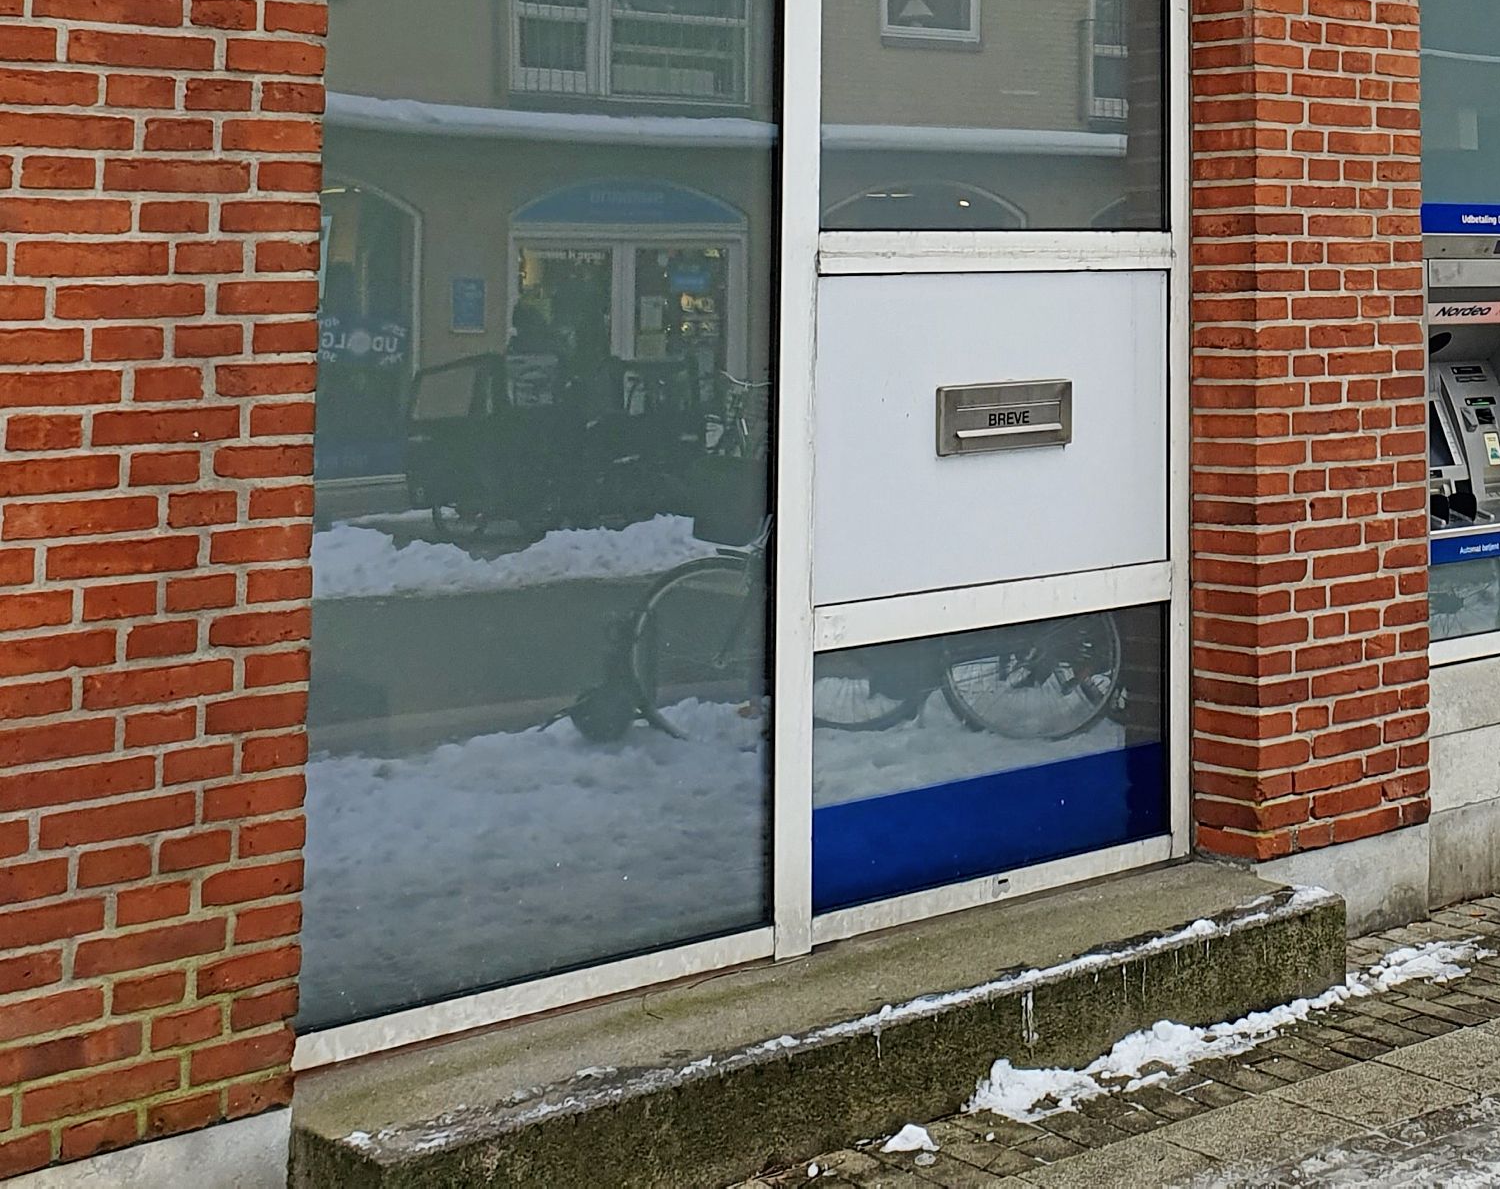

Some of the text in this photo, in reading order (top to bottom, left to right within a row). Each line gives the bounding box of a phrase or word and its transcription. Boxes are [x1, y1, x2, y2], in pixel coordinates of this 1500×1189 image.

[1461, 214, 1498, 226] Udbetaling
[1435, 305, 1492, 317] Nordea
[988, 410, 1030, 427] BREVE
